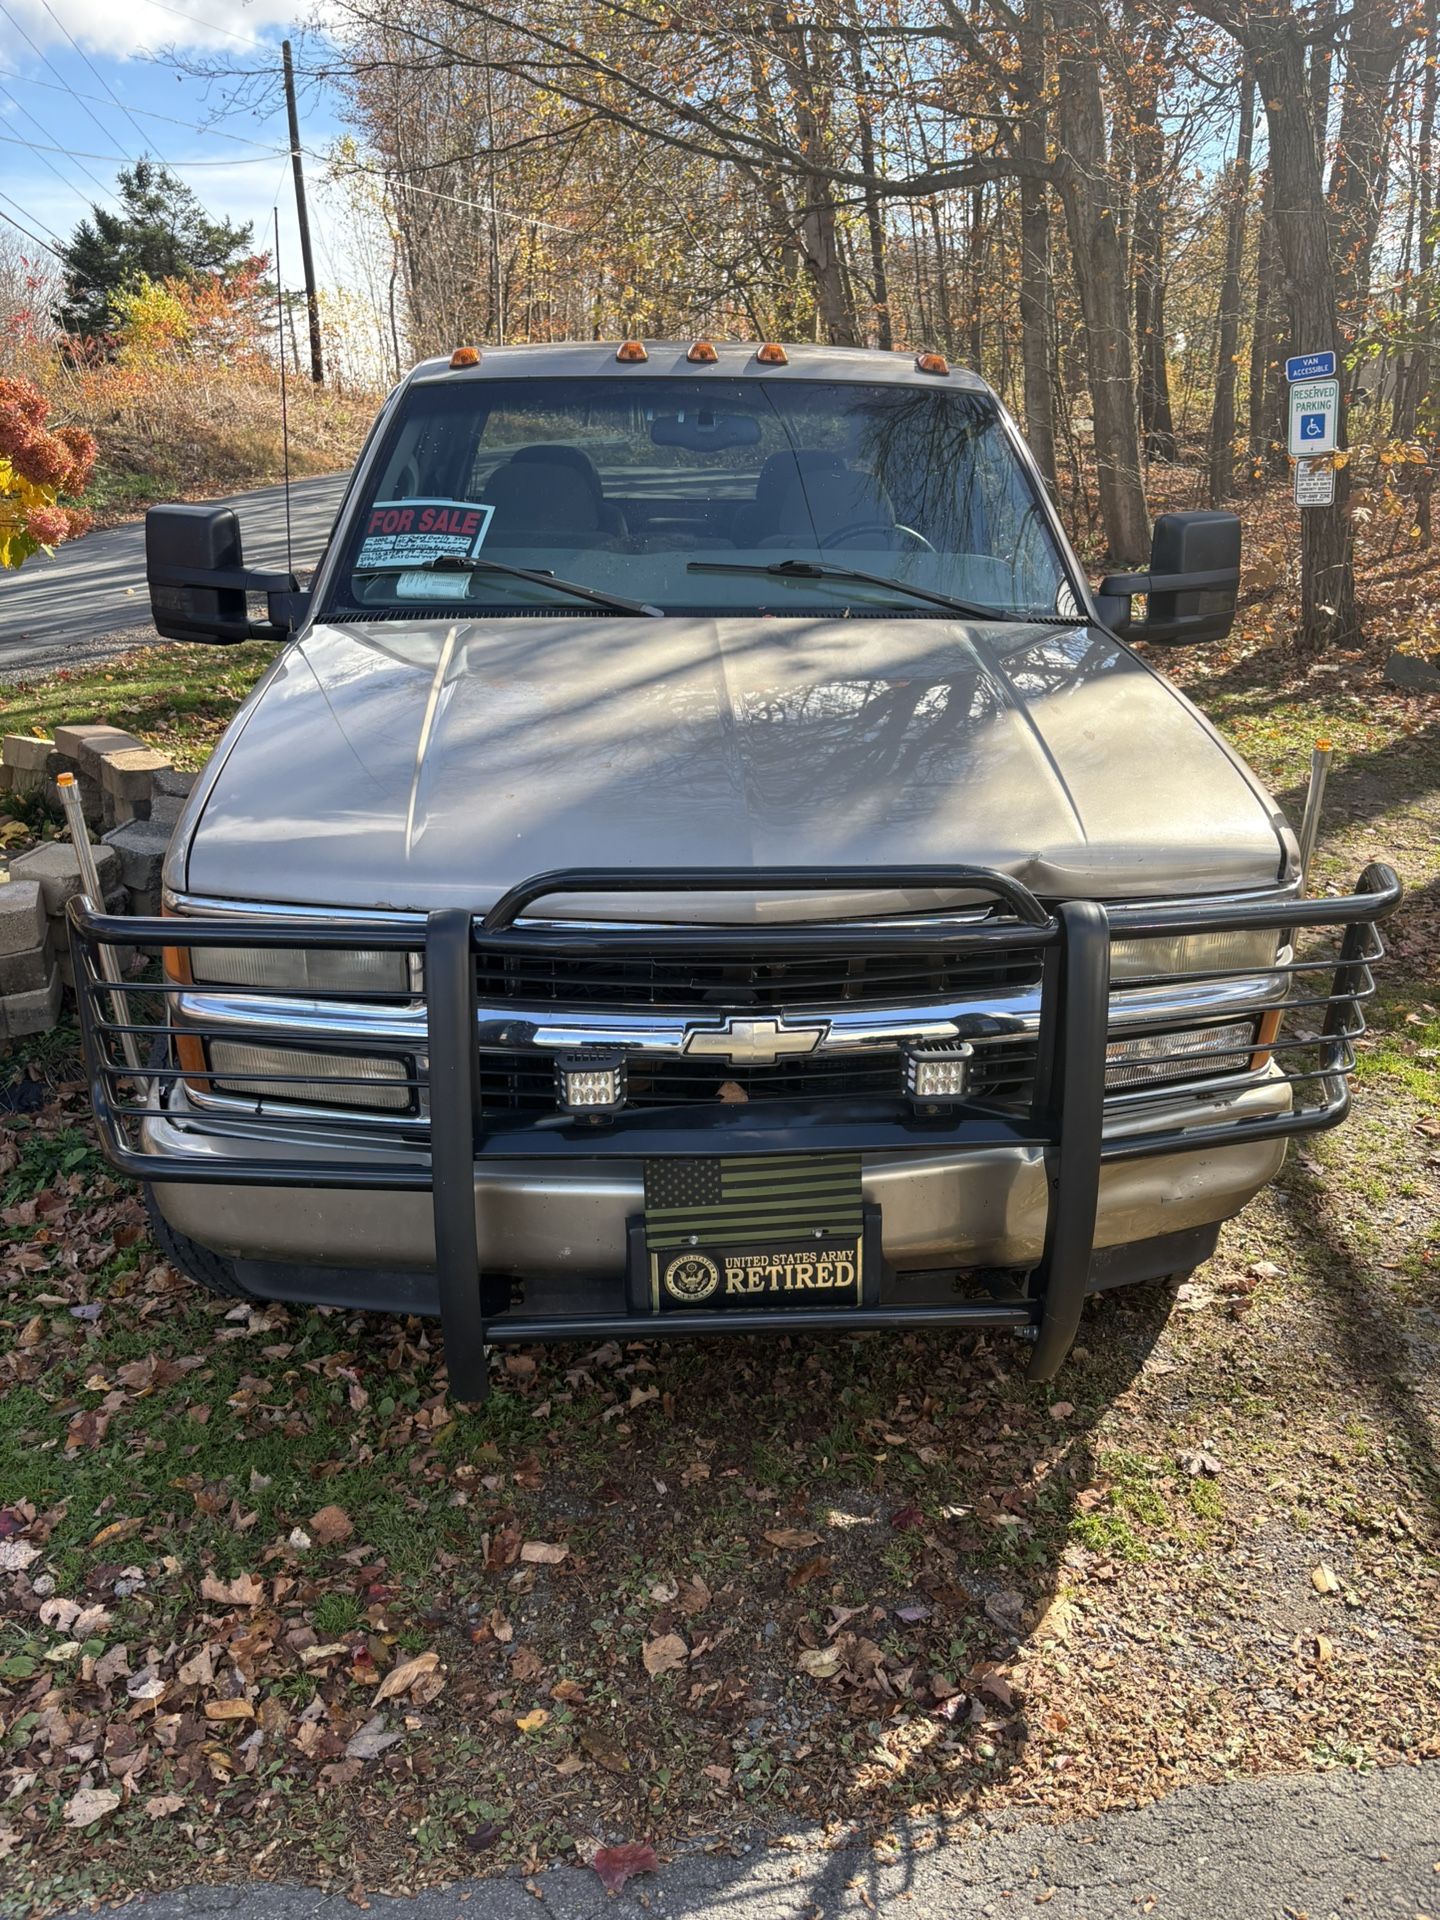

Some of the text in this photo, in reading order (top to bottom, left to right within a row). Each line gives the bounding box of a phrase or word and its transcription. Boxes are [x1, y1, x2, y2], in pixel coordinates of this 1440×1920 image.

[1302, 357, 1319, 366] VAN
[1292, 364, 1329, 377] ACCESSIBLE
[1293, 387, 1335, 400] RESERVED
[1295, 400, 1332, 412] PARKING
[368, 508, 481, 535] FOR SALE
[725, 1250, 855, 1269] UNITED STATES ARMY
[725, 1261, 855, 1295] RETIRED
